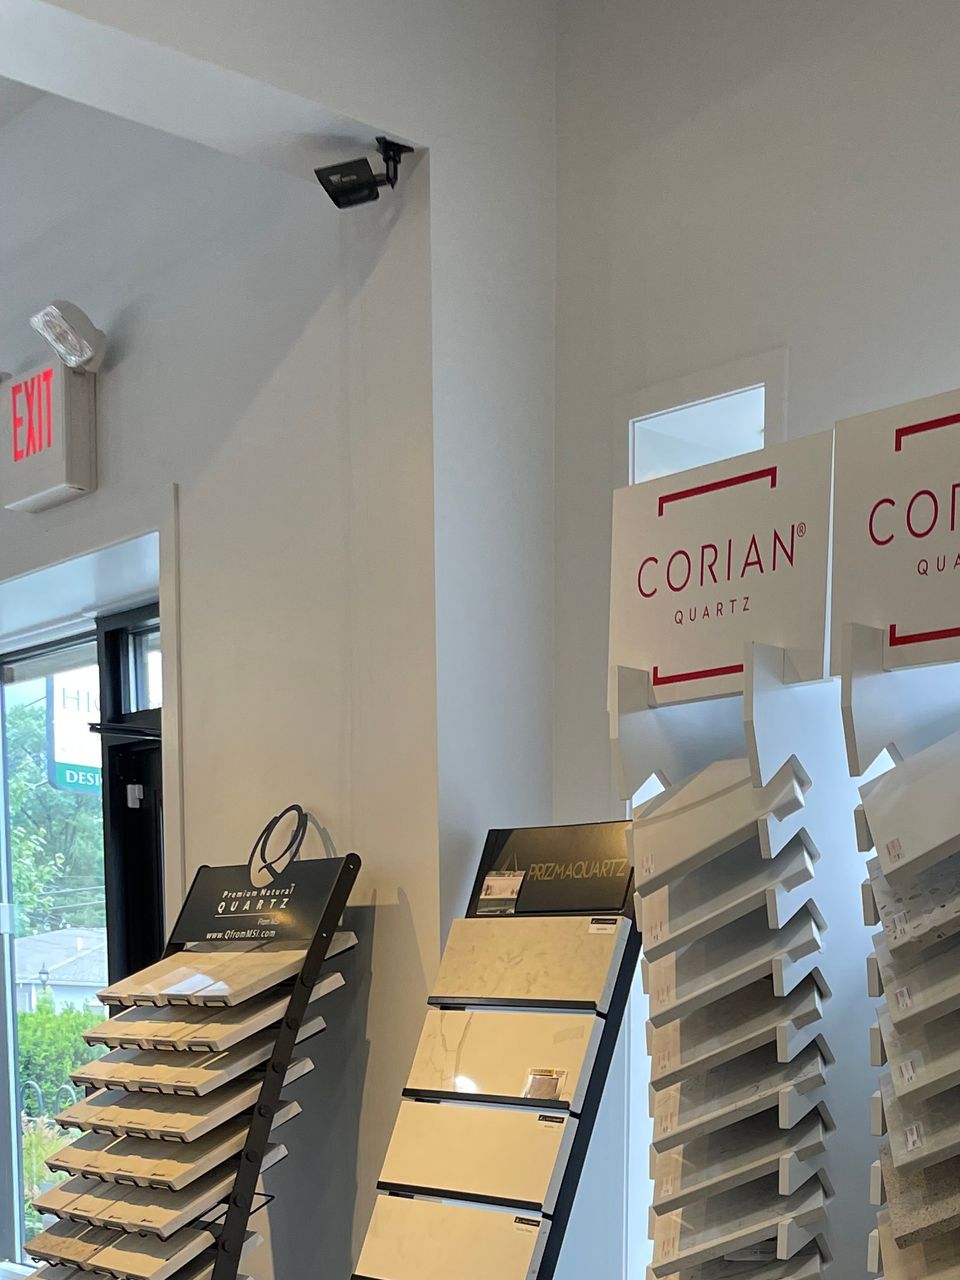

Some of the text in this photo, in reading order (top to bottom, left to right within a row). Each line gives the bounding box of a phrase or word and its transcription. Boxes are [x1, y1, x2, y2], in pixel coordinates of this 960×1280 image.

[11, 368, 54, 462] EXIT
[674, 596, 750, 625] QUARTZ
[66, 768, 102, 787] DESI
[527, 858, 628, 881] PRIZMAQUARTZ
[222, 886, 295, 899] Premium Natural
[217, 898, 290, 914] QUARTZ
